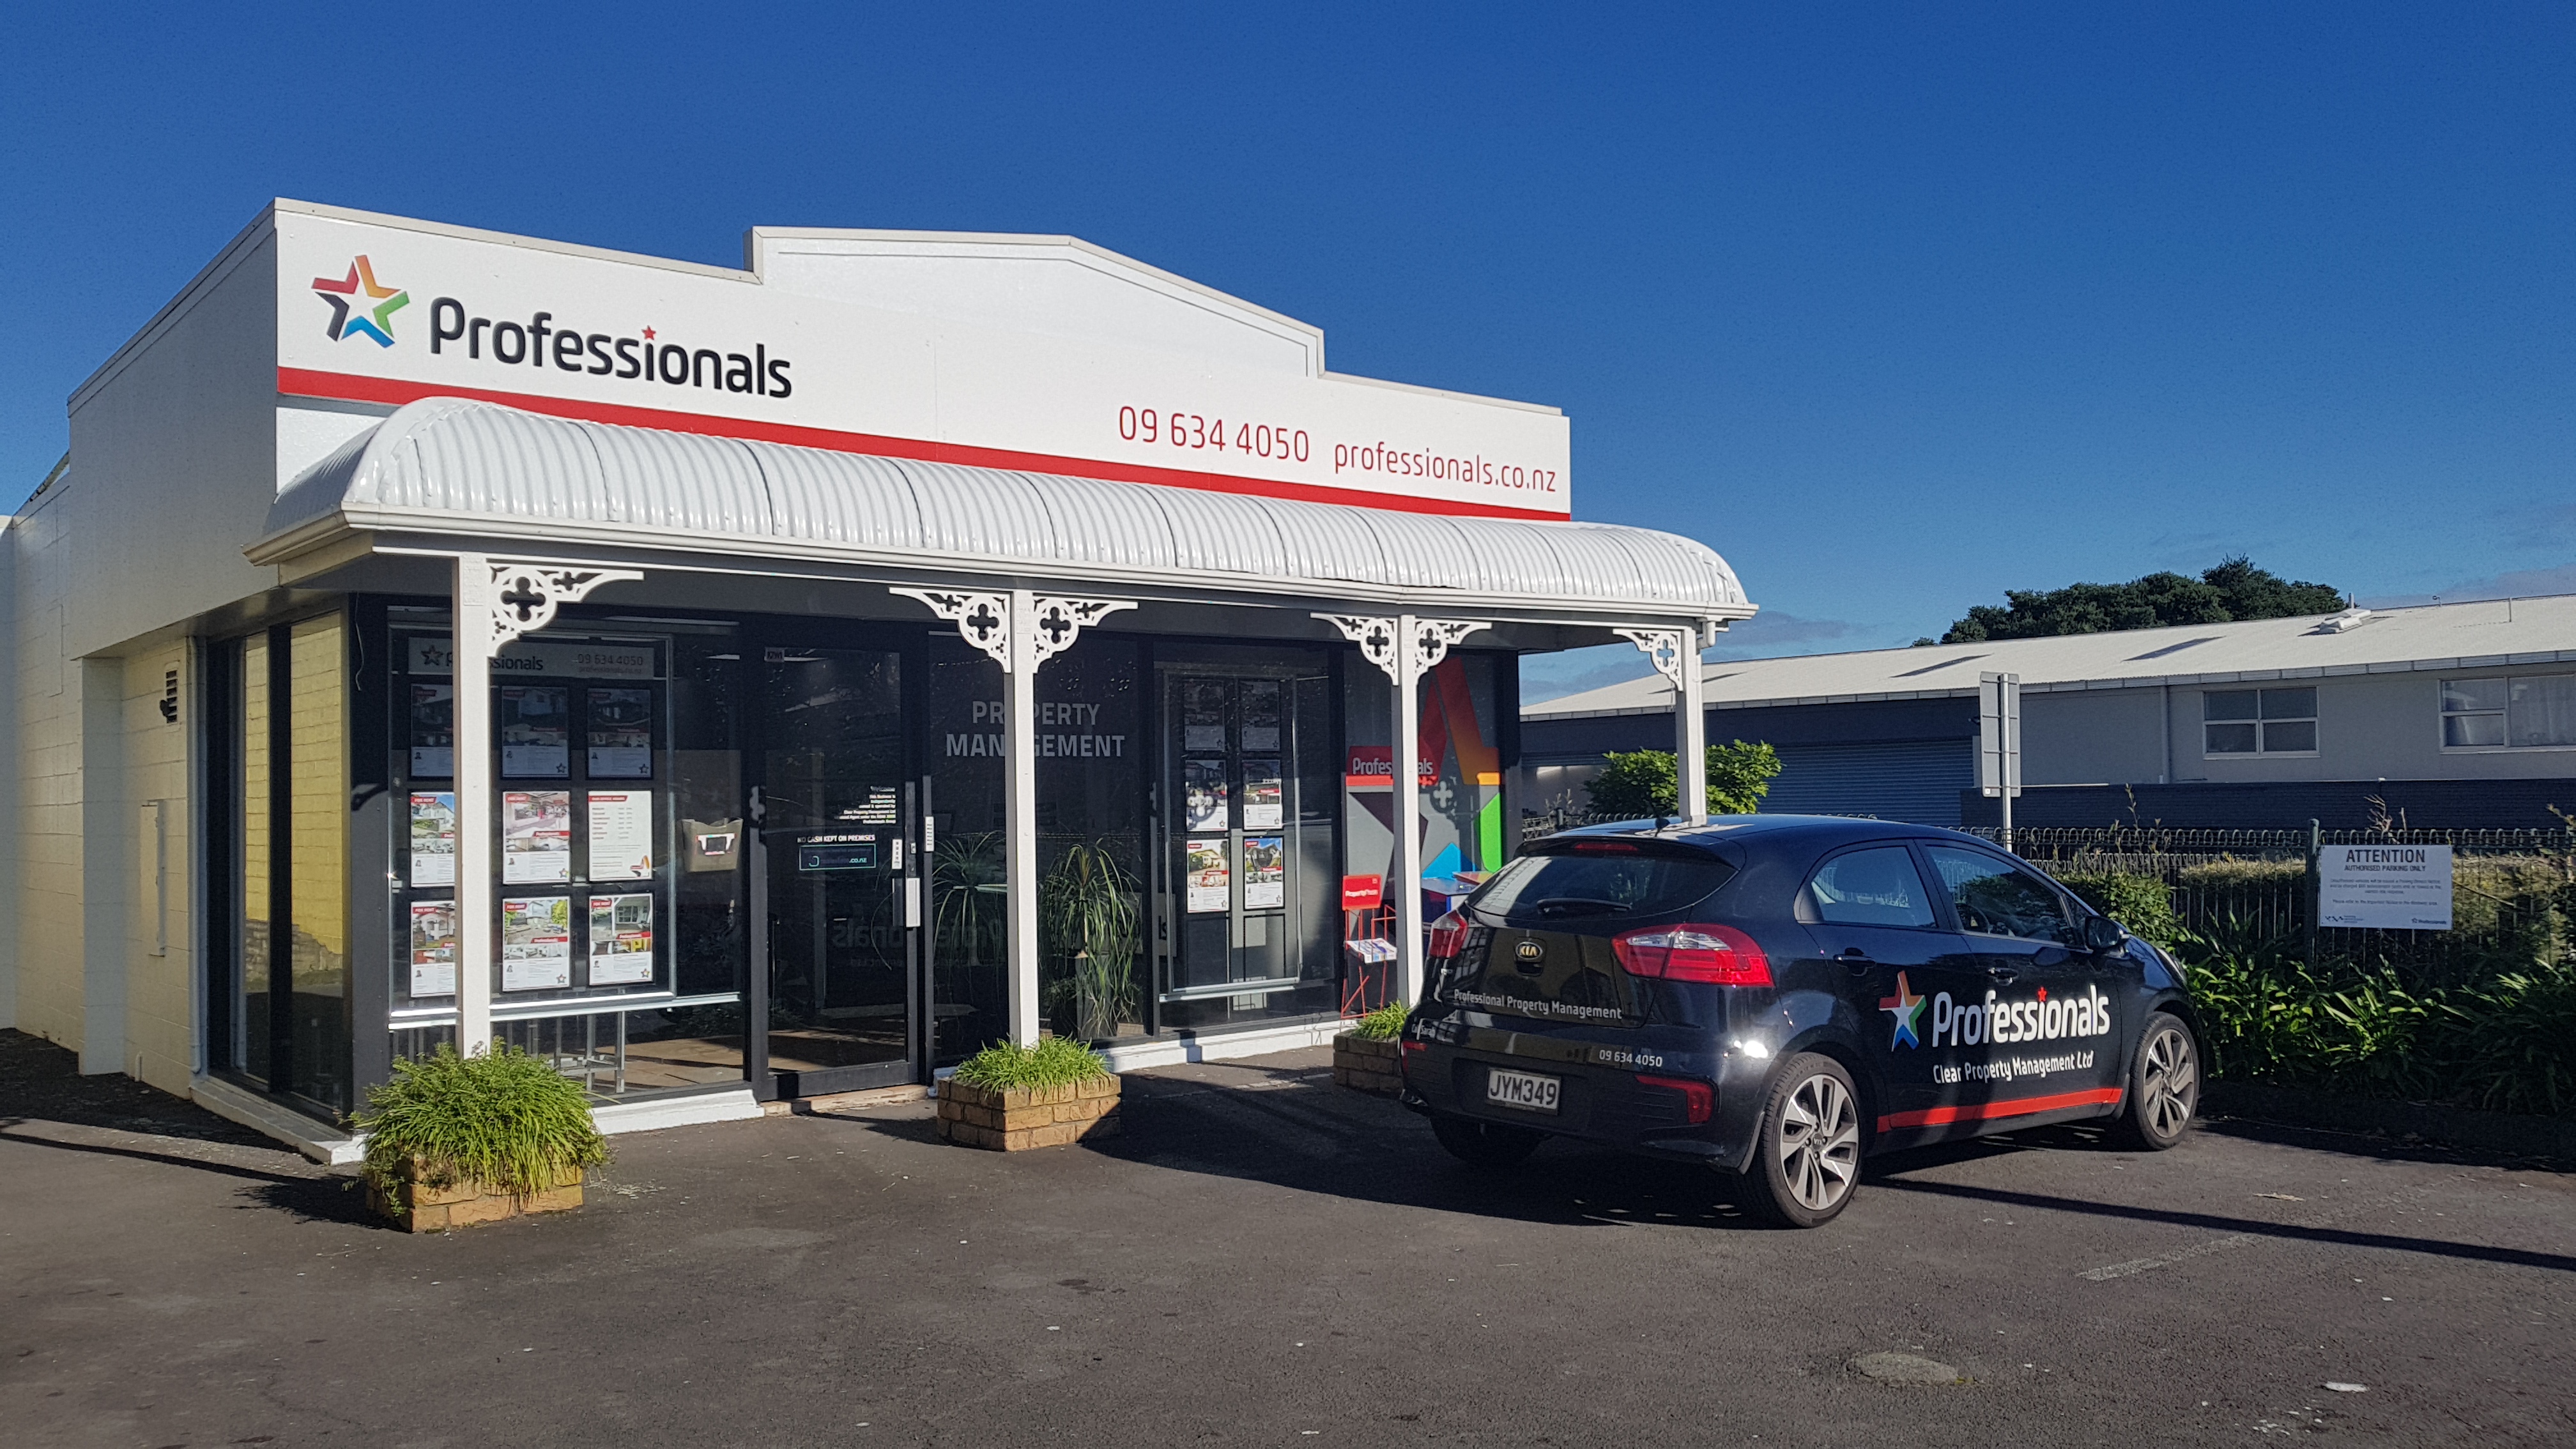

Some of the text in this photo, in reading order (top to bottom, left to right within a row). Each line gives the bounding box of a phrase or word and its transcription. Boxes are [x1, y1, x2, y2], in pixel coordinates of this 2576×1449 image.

[430, 296, 792, 398] Professionals
[1119, 406, 1308, 462] 09 634 4050
[1335, 441, 1556, 493] professionals.co.nz
[446, 652, 543, 670] Psionals
[578, 654, 643, 666] 09 634 4050
[972, 701, 1100, 725] PRERTY
[946, 734, 1124, 757] MANEMENT
[1353, 757, 1433, 775] Profesals
[2346, 849, 2425, 863] ATTENTION
[1519, 946, 1537, 956] KIA
[1453, 989, 1622, 1019] Professional Property Management
[1933, 984, 2110, 1048] Professionals
[1599, 1050, 1663, 1067] 09 634 4050
[1933, 1050, 2094, 1084] Clear Property Management Ltd
[1490, 1075, 1556, 1105] JYM349
